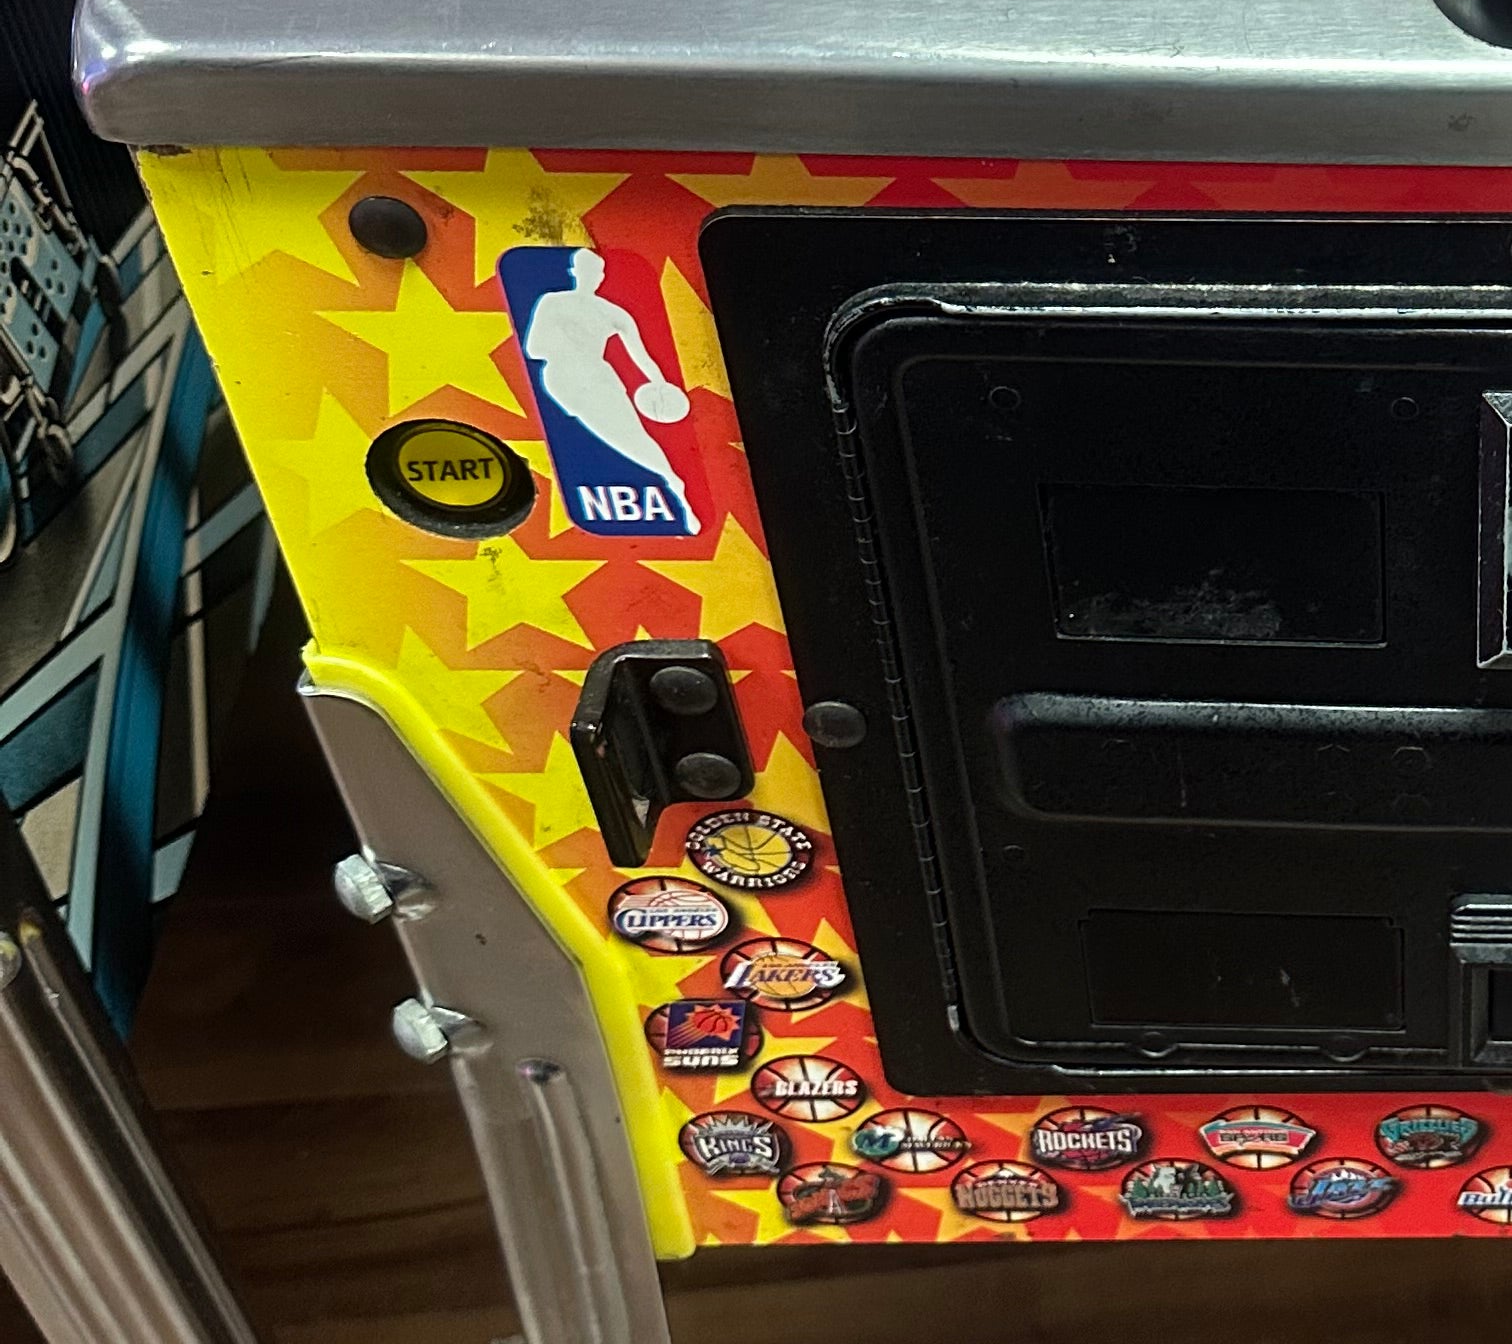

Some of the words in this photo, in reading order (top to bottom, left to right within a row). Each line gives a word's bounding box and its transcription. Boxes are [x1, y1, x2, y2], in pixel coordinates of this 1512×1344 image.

[407, 458, 494, 482] START
[577, 485, 674, 522] NBA
[685, 813, 749, 850] GOLDEN
[758, 814, 812, 850] STATE
[702, 860, 806, 887] WARRIORS
[617, 909, 718, 934] CLIPPERS
[725, 962, 845, 990] LAKERS
[775, 1080, 858, 1096] BLAZERS
[700, 1137, 772, 1158] KINGS
[1037, 1128, 1133, 1153] ROCKETS
[958, 1183, 1058, 1207] NUGGETS
